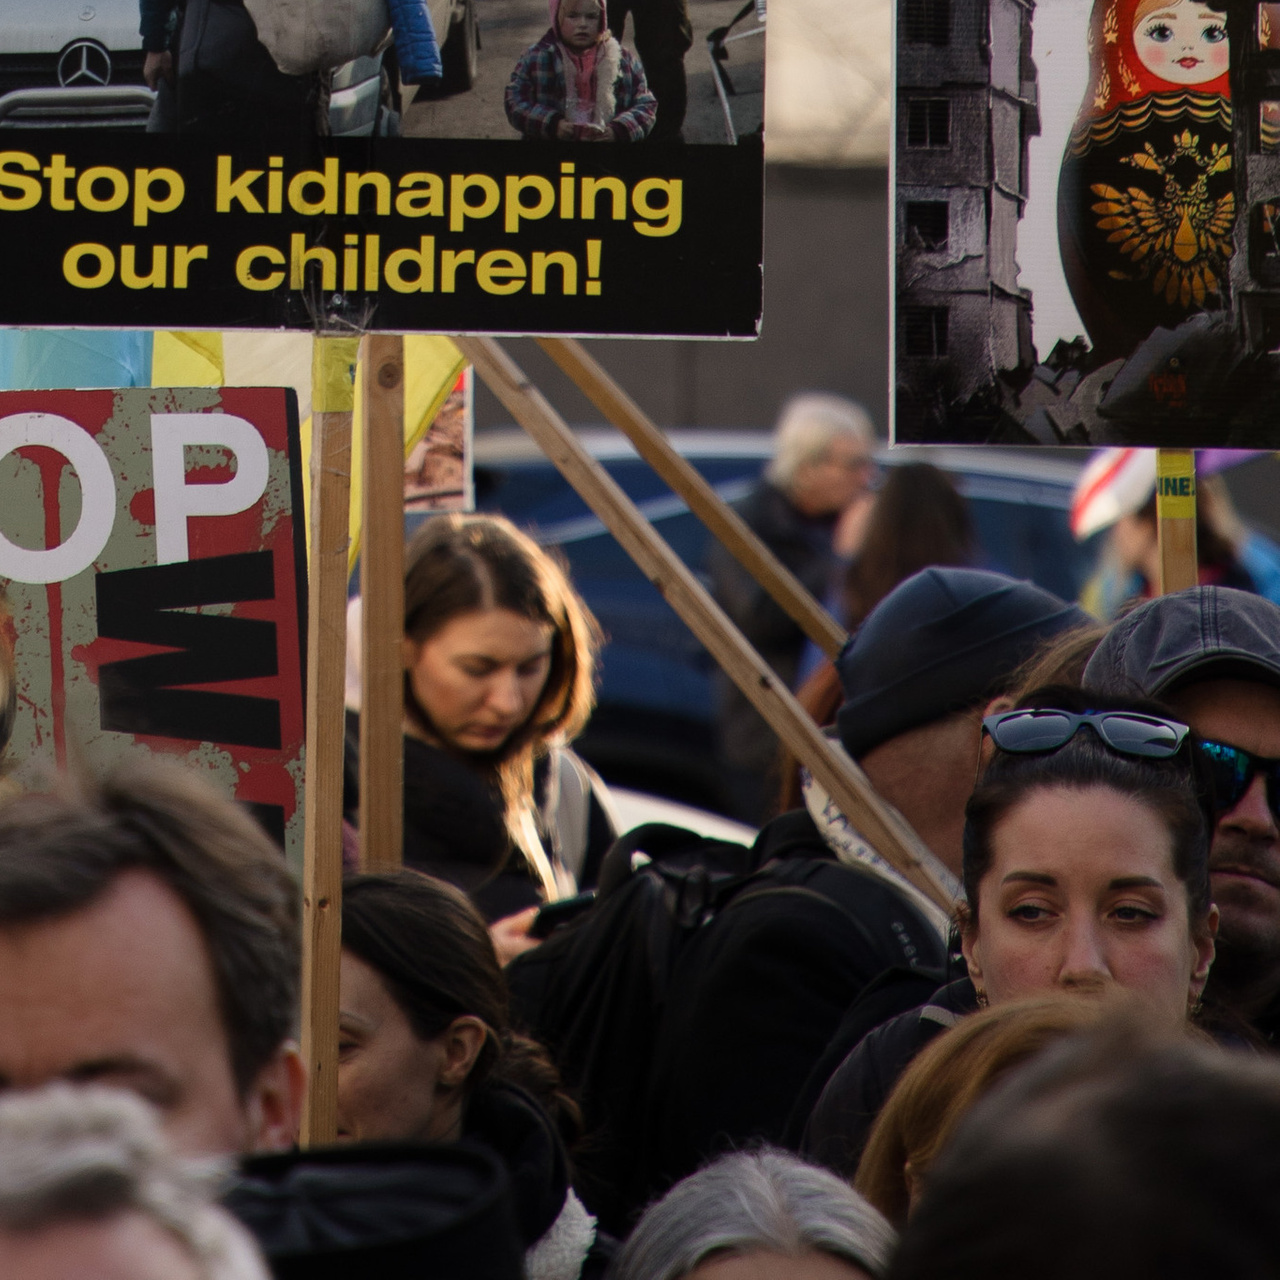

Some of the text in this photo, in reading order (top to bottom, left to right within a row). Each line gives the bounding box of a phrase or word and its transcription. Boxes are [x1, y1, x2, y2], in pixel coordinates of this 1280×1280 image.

[216, 155, 683, 237] kidnapping
[62, 233, 602, 296] our children!
